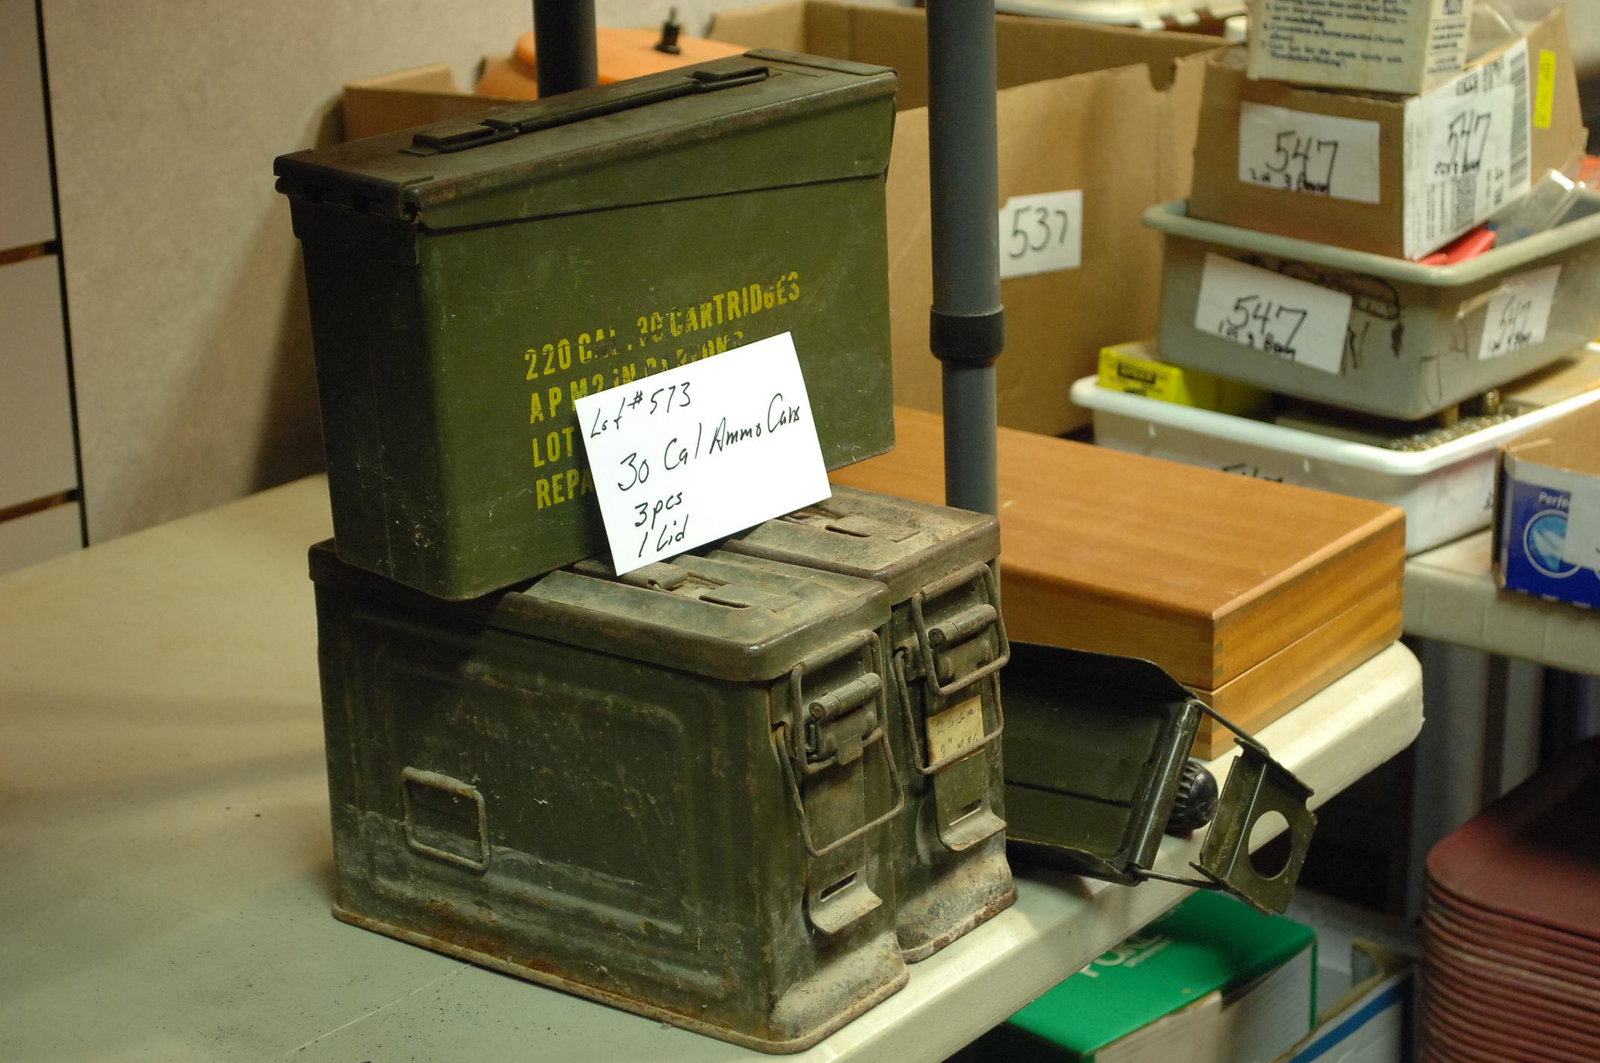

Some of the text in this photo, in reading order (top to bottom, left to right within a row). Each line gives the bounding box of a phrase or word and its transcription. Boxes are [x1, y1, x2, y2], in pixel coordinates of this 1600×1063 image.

[1265, 130, 1339, 193] 547
[1448, 108, 1492, 165] 547
[1008, 205, 1069, 260] 537
[1226, 294, 1308, 350] 547
[524, 337, 572, 381] 220
[578, 325, 619, 365] CA
[590, 397, 627, 439] Lot
[532, 426, 575, 468] LOT
[617, 452, 650, 491] 30
[663, 422, 702, 470] Cal
[709, 417, 762, 455] Ammo
